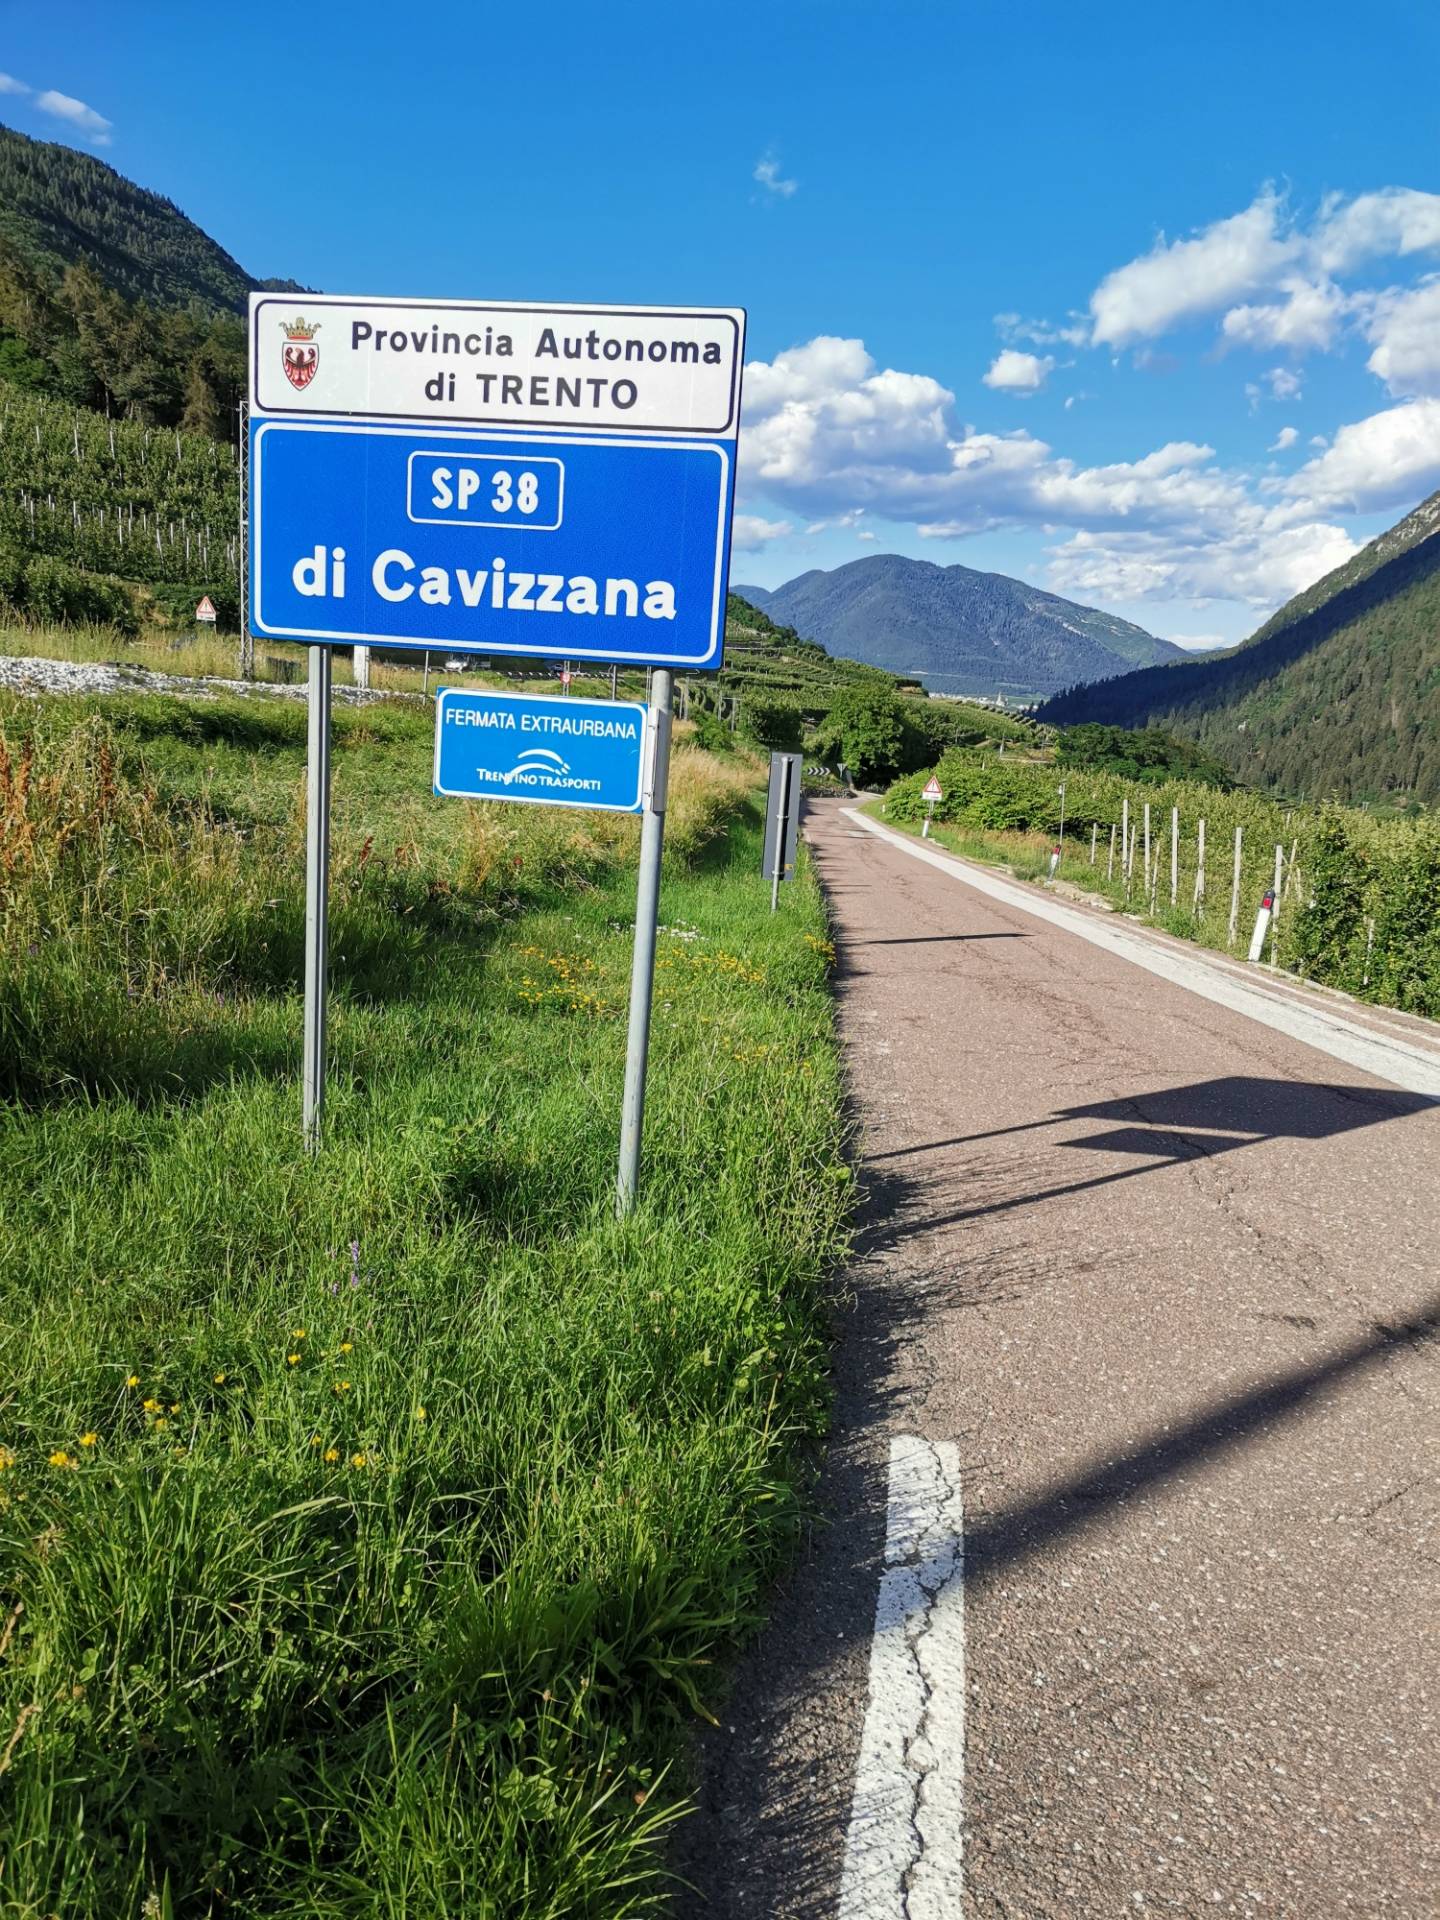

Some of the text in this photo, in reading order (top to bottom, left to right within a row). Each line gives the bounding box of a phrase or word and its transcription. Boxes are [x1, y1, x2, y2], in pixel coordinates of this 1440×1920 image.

[351, 321, 722, 365] Provincia Autonoma
[424, 372, 638, 410] di TRENTO
[431, 467, 539, 515] SP 38
[292, 545, 677, 620] di Cavizzana
[446, 708, 637, 740] FERMATA EXTRAURBANA
[539, 775, 602, 791] TRASPORTI
